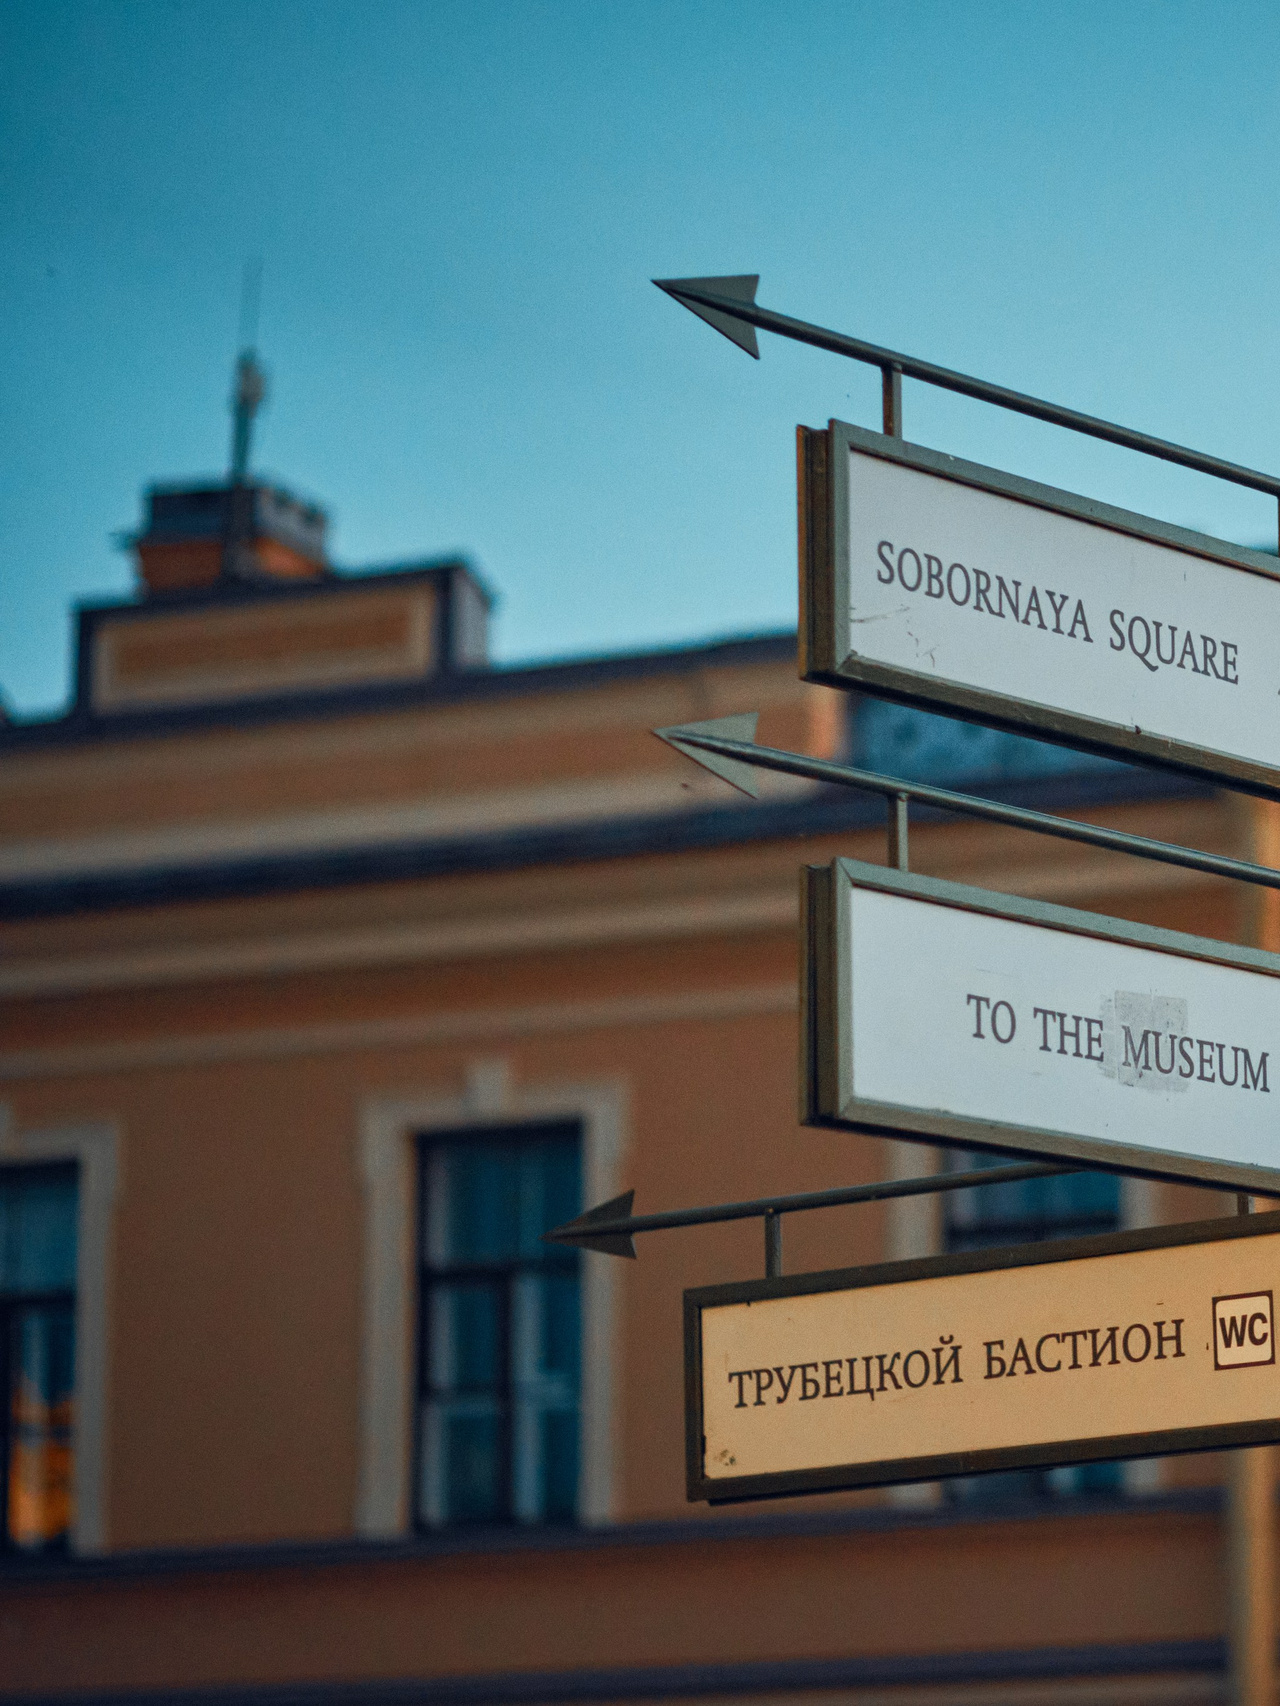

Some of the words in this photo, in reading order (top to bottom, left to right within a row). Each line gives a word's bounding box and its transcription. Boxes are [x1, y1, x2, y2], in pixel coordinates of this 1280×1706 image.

[876, 540, 1094, 643] SOBORNAYA
[1108, 609, 1239, 685] SQUARE
[966, 994, 1017, 1044] TO
[1033, 1007, 1105, 1063] THE
[1121, 1025, 1272, 1094] MUSEUM
[728, 1335, 964, 1409] ТРУБЕЦКОЙ
[983, 1319, 1186, 1381] БАСТИОН
[1218, 1311, 1270, 1350] WC
